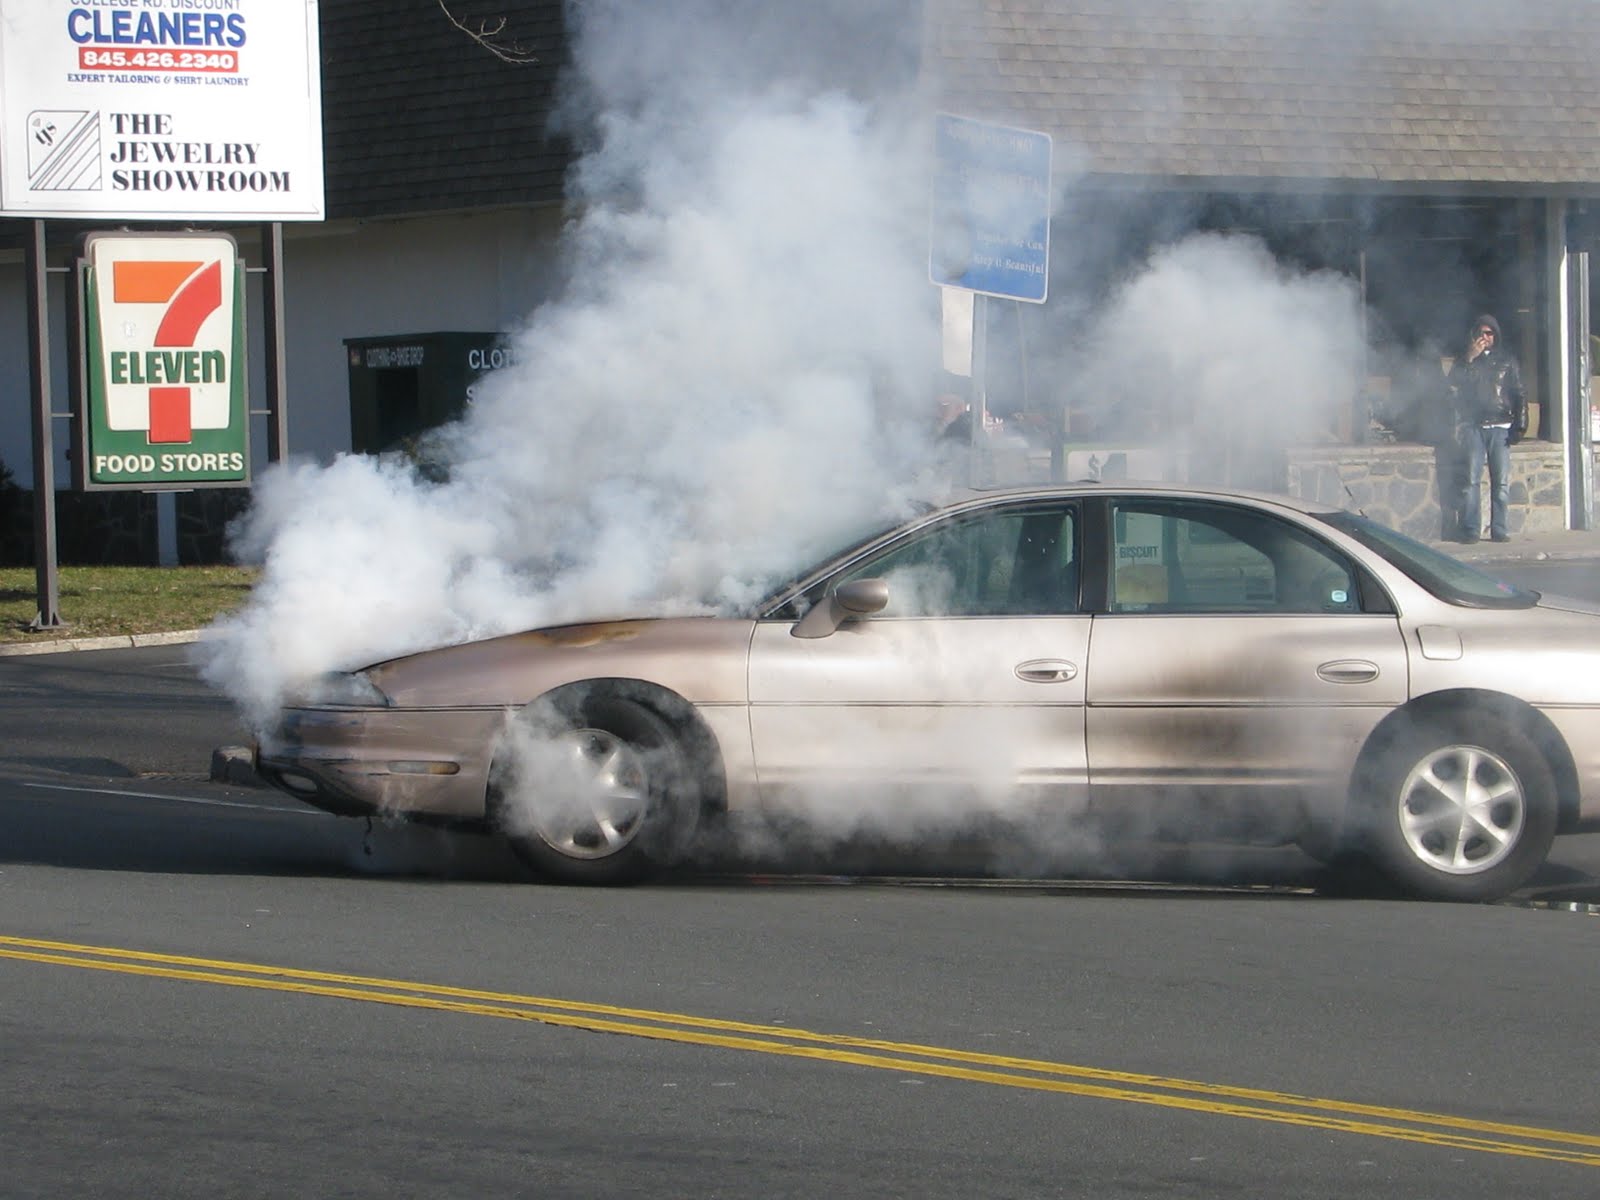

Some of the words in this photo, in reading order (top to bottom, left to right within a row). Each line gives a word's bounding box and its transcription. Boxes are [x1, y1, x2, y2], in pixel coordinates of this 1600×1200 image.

[171, 0, 240, 10] DISCOUNT
[67, 8, 247, 48] CLEANERS
[83, 51, 235, 69] 845.426.2340
[67, 73, 106, 83] EXPERT
[109, 74, 161, 84] TAILORING
[163, 74, 171, 84] &
[174, 75, 203, 85] SHIRT
[205, 76, 249, 86] LAUNDRY
[110, 113, 173, 135] THE
[110, 141, 261, 164] JEWELRY
[112, 169, 291, 192] SHOWROOM
[469, 349, 520, 369] CLOT
[96, 455, 155, 474] FOOD
[161, 453, 243, 472] STORES
